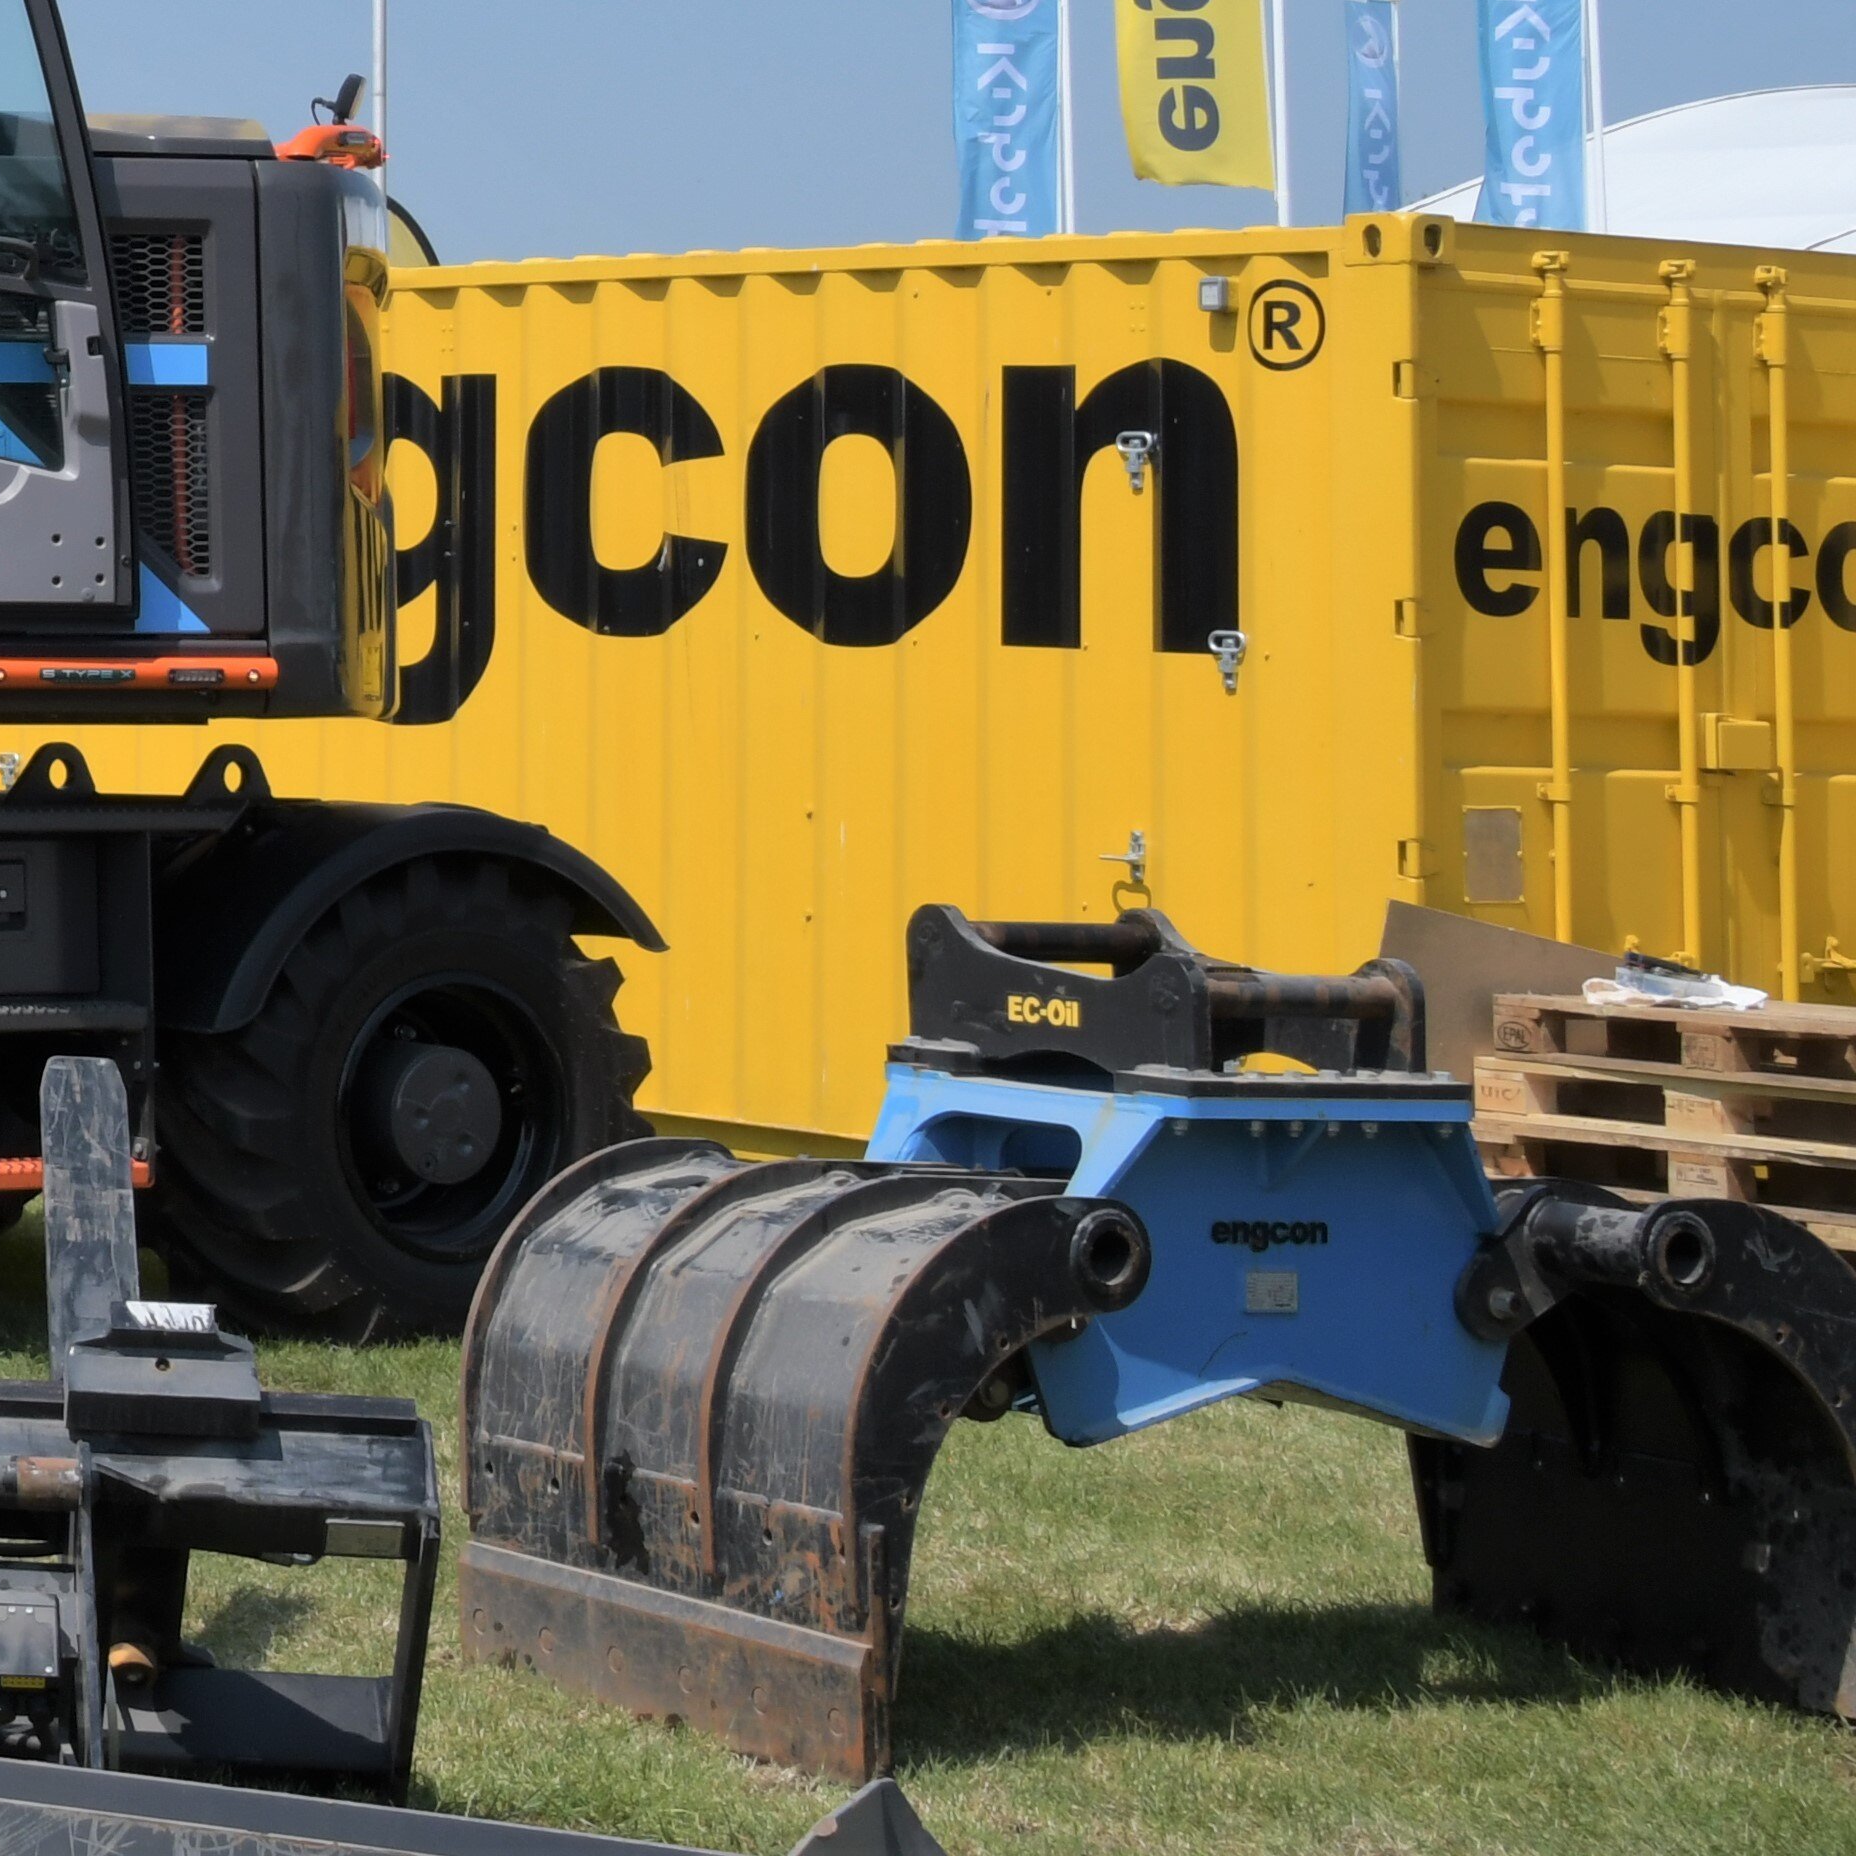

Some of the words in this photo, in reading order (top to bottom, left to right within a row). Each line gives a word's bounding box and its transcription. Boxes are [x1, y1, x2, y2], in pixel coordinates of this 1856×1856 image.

[383, 358, 1239, 725] gcon
[1006, 993, 1081, 1030] EC-Oil
[1211, 1220, 1328, 1253] engcon
